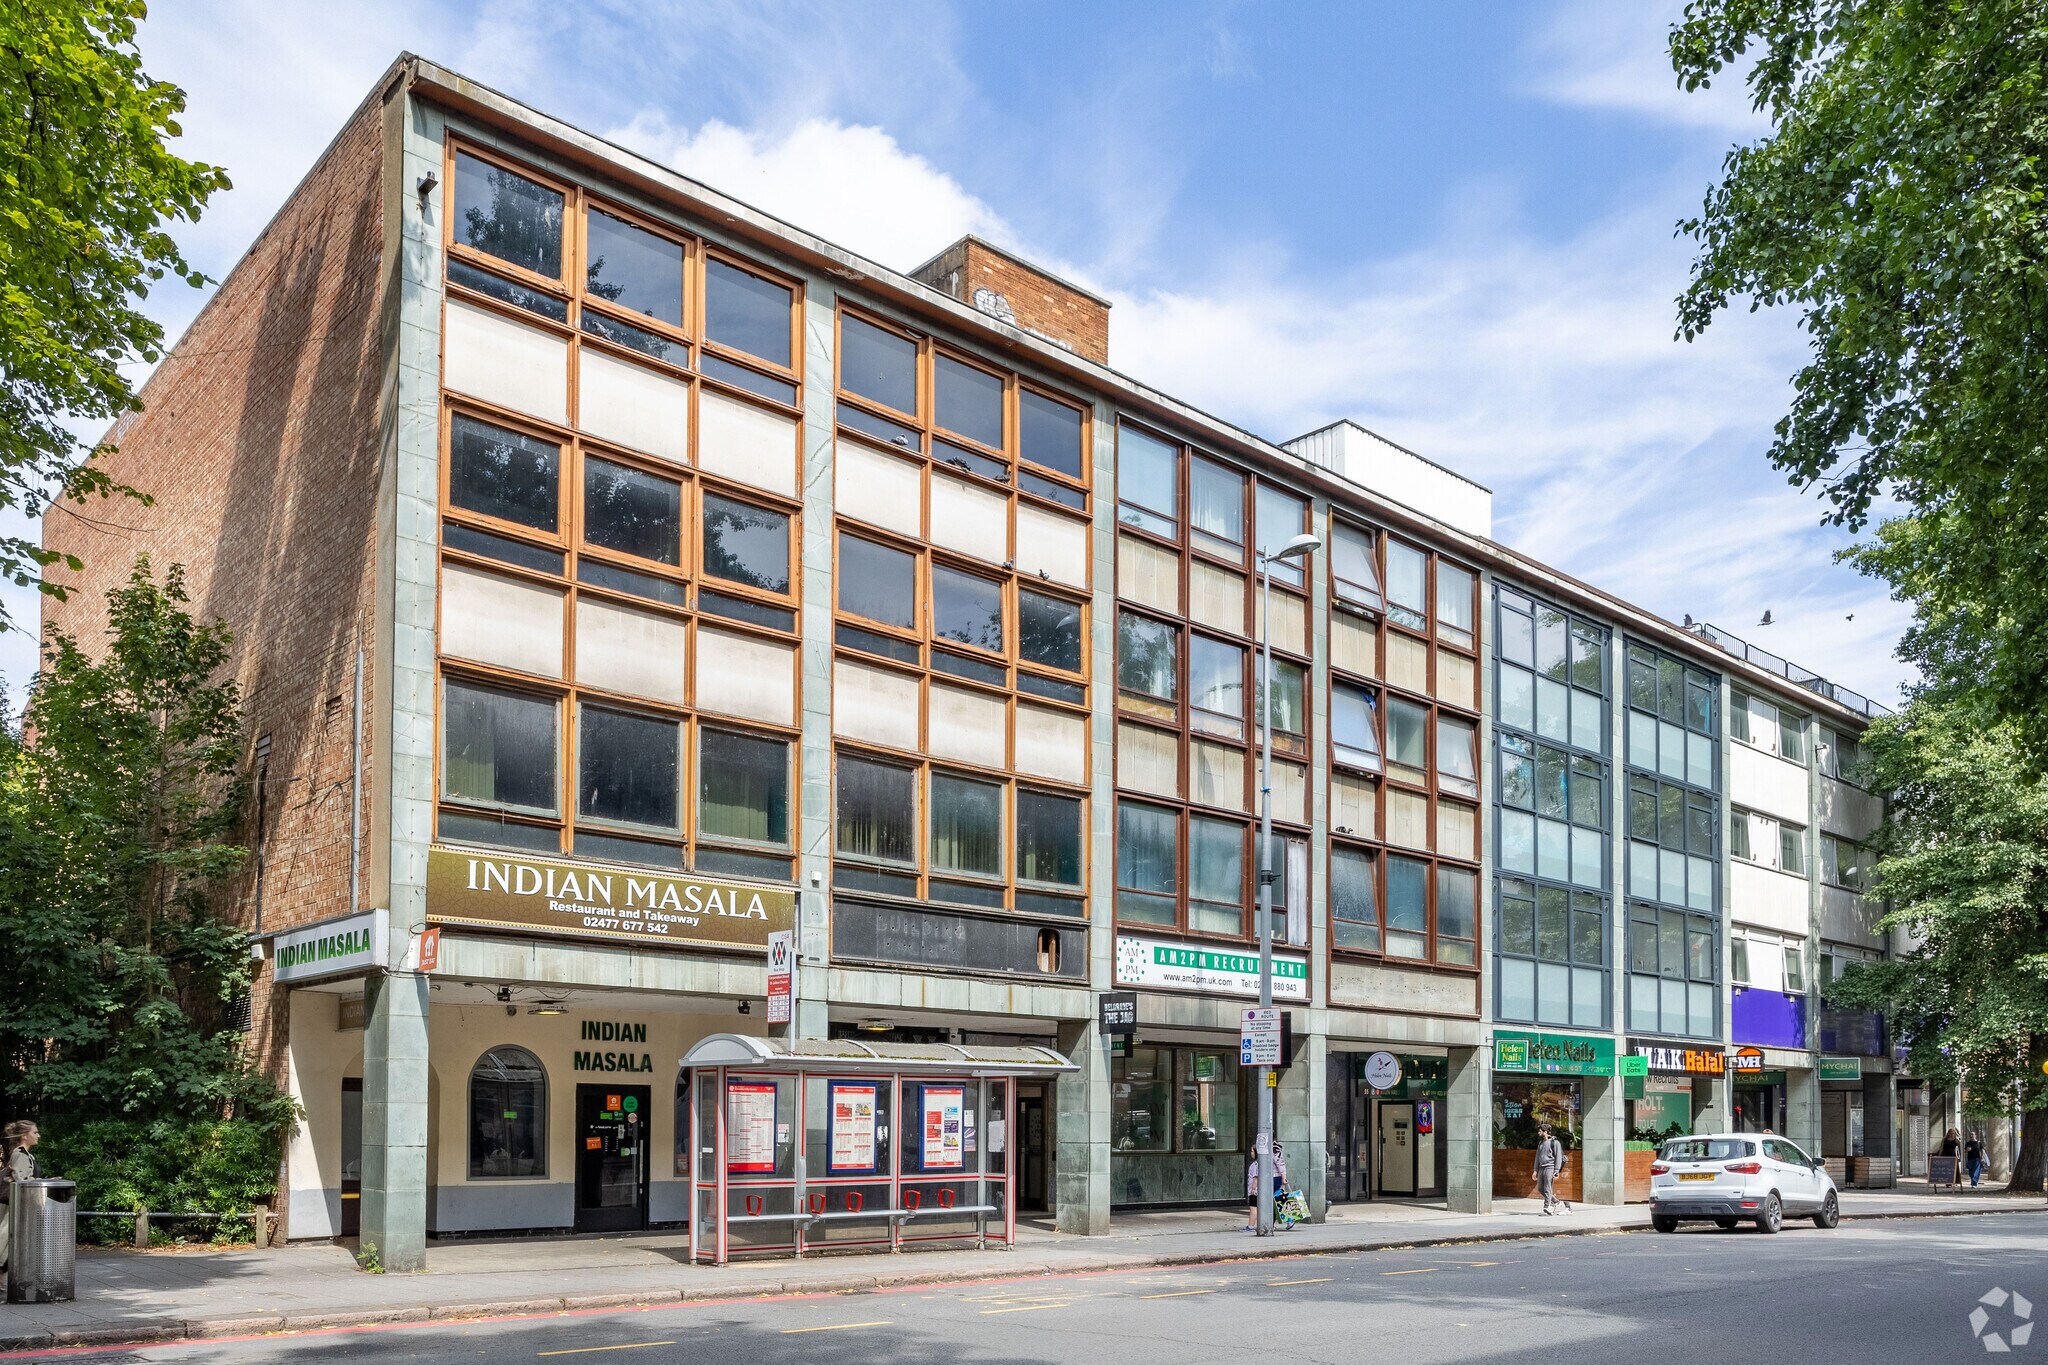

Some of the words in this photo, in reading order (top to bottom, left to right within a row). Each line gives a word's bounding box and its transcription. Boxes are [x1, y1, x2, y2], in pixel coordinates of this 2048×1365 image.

[466, 859, 613, 906] INDIAN
[625, 877, 769, 921] MASALA
[549, 900, 616, 918] Restaurant
[618, 908, 640, 920] and
[642, 910, 700, 927] Takeaway
[583, 916, 620, 930] 02477
[622, 919, 645, 932] 677
[646, 921, 668, 934] 542
[276, 940, 316, 970] INDIAN
[317, 928, 371, 960] MASALA
[1124, 947, 1139, 958] AM
[1125, 964, 1139, 975] PM
[1159, 949, 1206, 968] AM2PM
[1214, 955, 1302, 977] RECRUIMENT
[1163, 973, 1233, 987] www.am2pm.uk.com
[1241, 979, 1253, 989] Tel:
[1273, 982, 1285, 991] 880
[1285, 984, 1297, 992] 943
[1103, 1012, 1119, 1024] THE
[581, 1020, 647, 1043] INDIAN
[1501, 1044, 1524, 1053] Helen
[1502, 1053, 1522, 1062] Nails
[1562, 1039, 1597, 1063] Nails
[573, 1050, 653, 1073] MASALA
[1243, 1054, 1250, 1063] P
[1635, 1046, 1683, 1070] MAK
[1683, 1050, 1724, 1073] Halal
[1737, 1056, 1762, 1068] MH
[1821, 1062, 1857, 1070] MYCHAI
[1732, 1074, 1769, 1082] YCHAI
